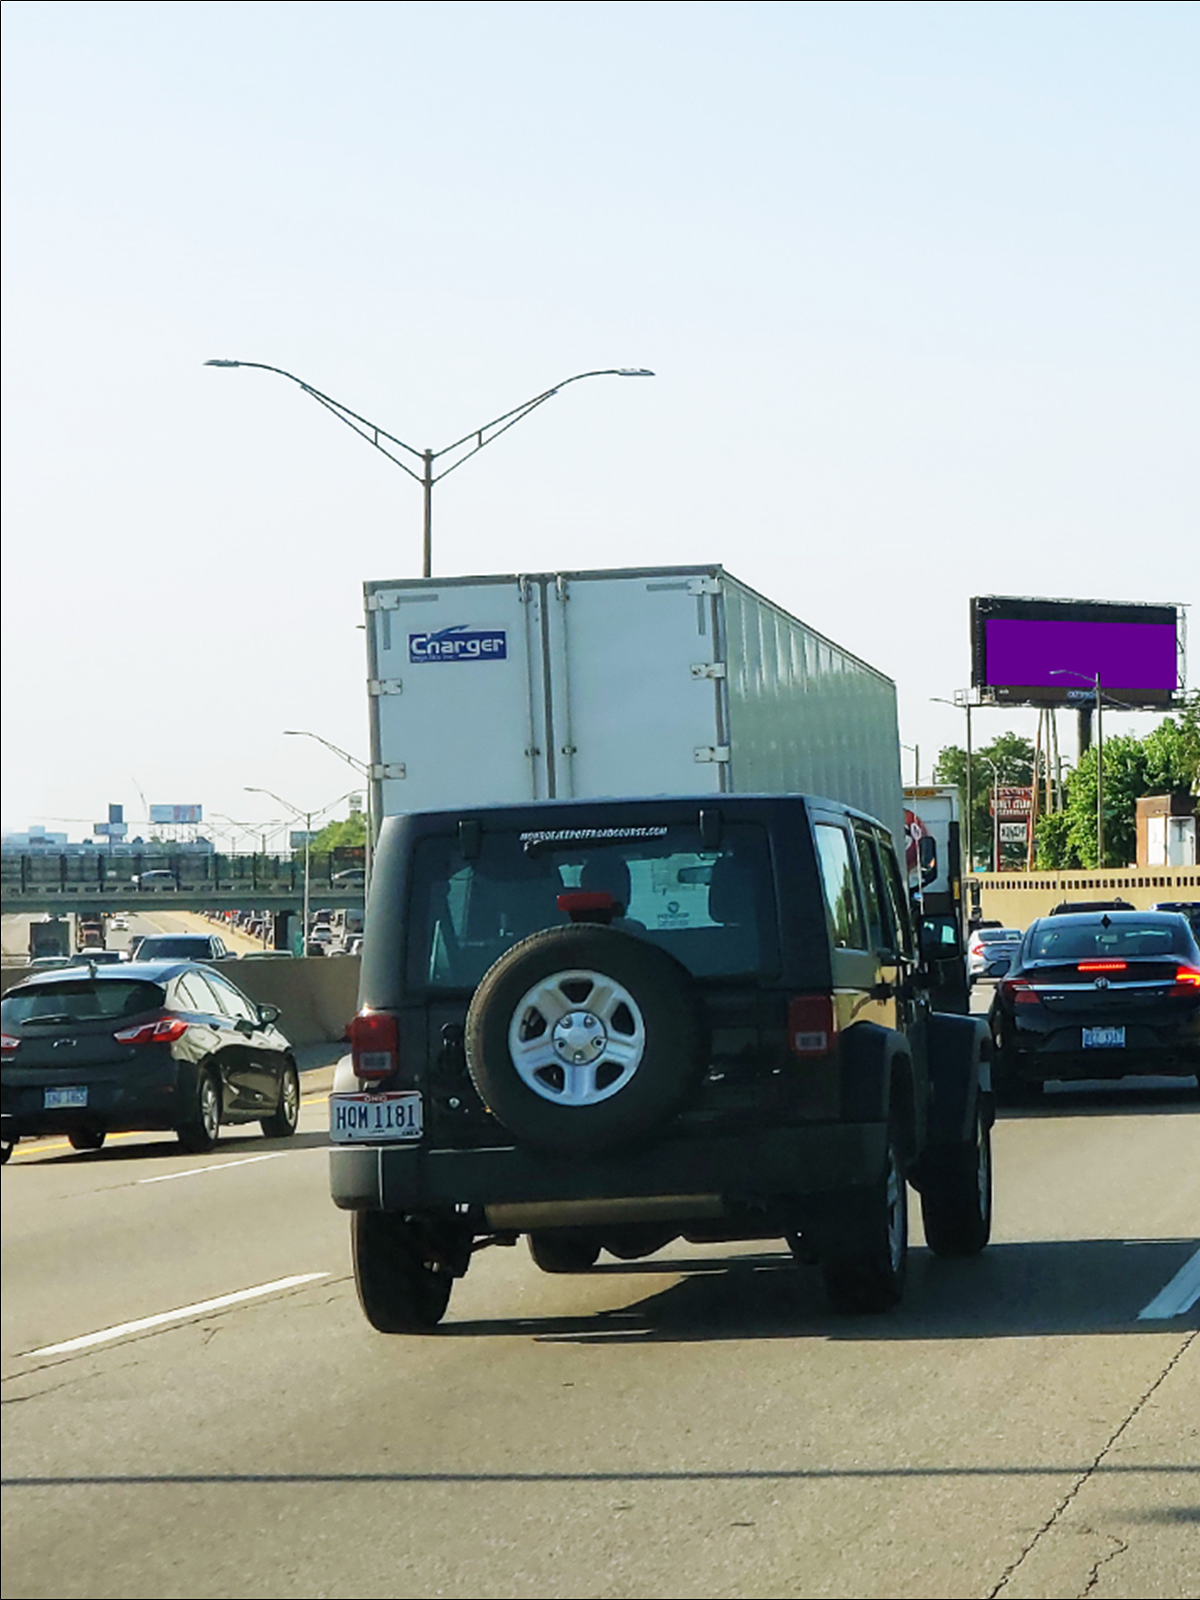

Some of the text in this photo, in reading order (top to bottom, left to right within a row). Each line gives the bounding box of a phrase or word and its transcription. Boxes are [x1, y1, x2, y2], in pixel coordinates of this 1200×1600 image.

[411, 633, 505, 658] Charger
[364, 1095, 387, 1103] OHIO
[336, 1104, 415, 1129] HQM 1181
